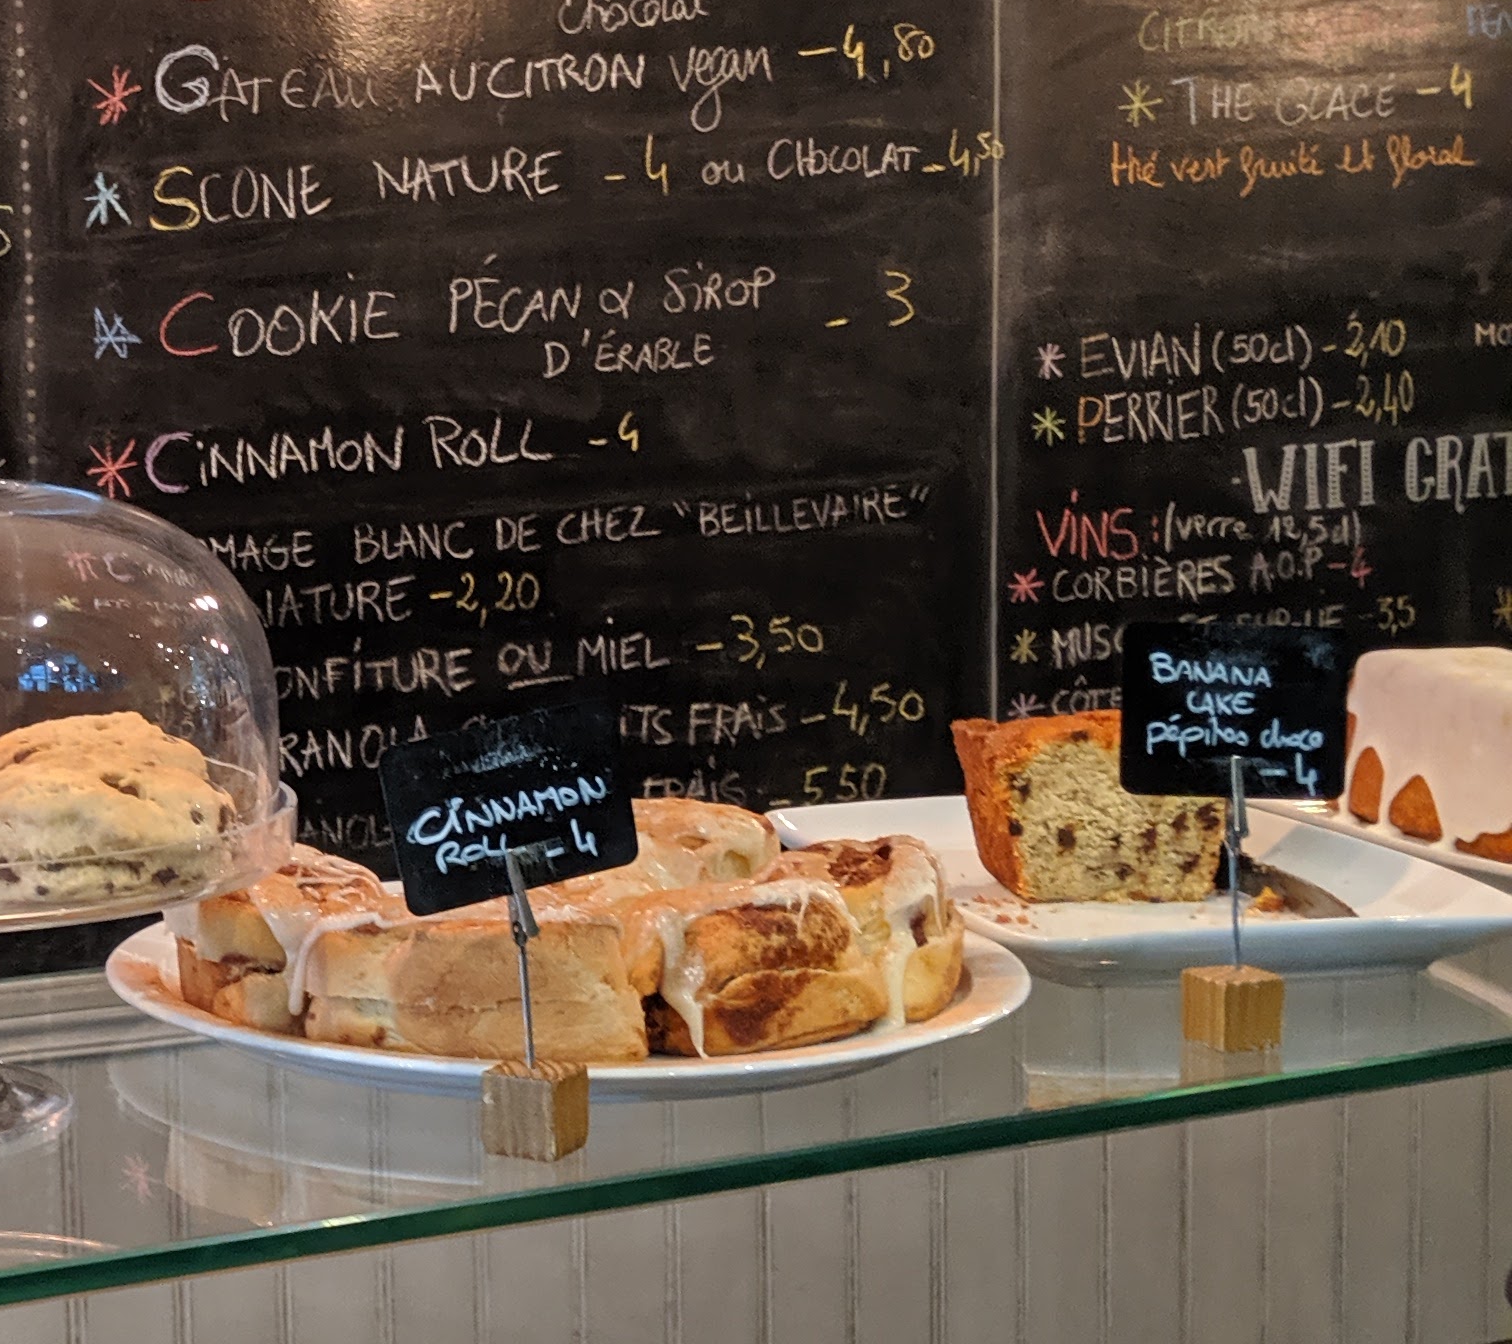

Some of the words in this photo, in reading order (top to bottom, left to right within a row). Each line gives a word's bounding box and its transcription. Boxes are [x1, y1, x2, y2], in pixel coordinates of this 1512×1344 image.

[415, 61, 477, 104] AU
[487, 52, 644, 99] CITRON
[149, 166, 334, 232] SCONE
[372, 147, 562, 201] NATURE
[767, 138, 921, 183] CHOCOLAT
[159, 272, 400, 358] COOKIE
[448, 254, 581, 333] PÉCAN
[664, 261, 776, 314] SIROP
[1080, 322, 1201, 380] EVIAN
[1078, 380, 1225, 444] PERRIER
[145, 427, 405, 494] CINNAMON
[423, 416, 553, 469] ROLL
[1242, 437, 1376, 514] WIFI
[354, 521, 474, 565] BLANC
[495, 515, 542, 553] DE
[556, 506, 662, 543] CHEZ
[1037, 489, 1139, 561] VINS
[498, 640, 555, 678] OU
[578, 617, 672, 677] MIEL
[1150, 651, 1272, 688] BANANA
[688, 693, 789, 745] FRAIS
[1187, 690, 1257, 717] CAKE
[406, 775, 608, 846] CINNAMON
